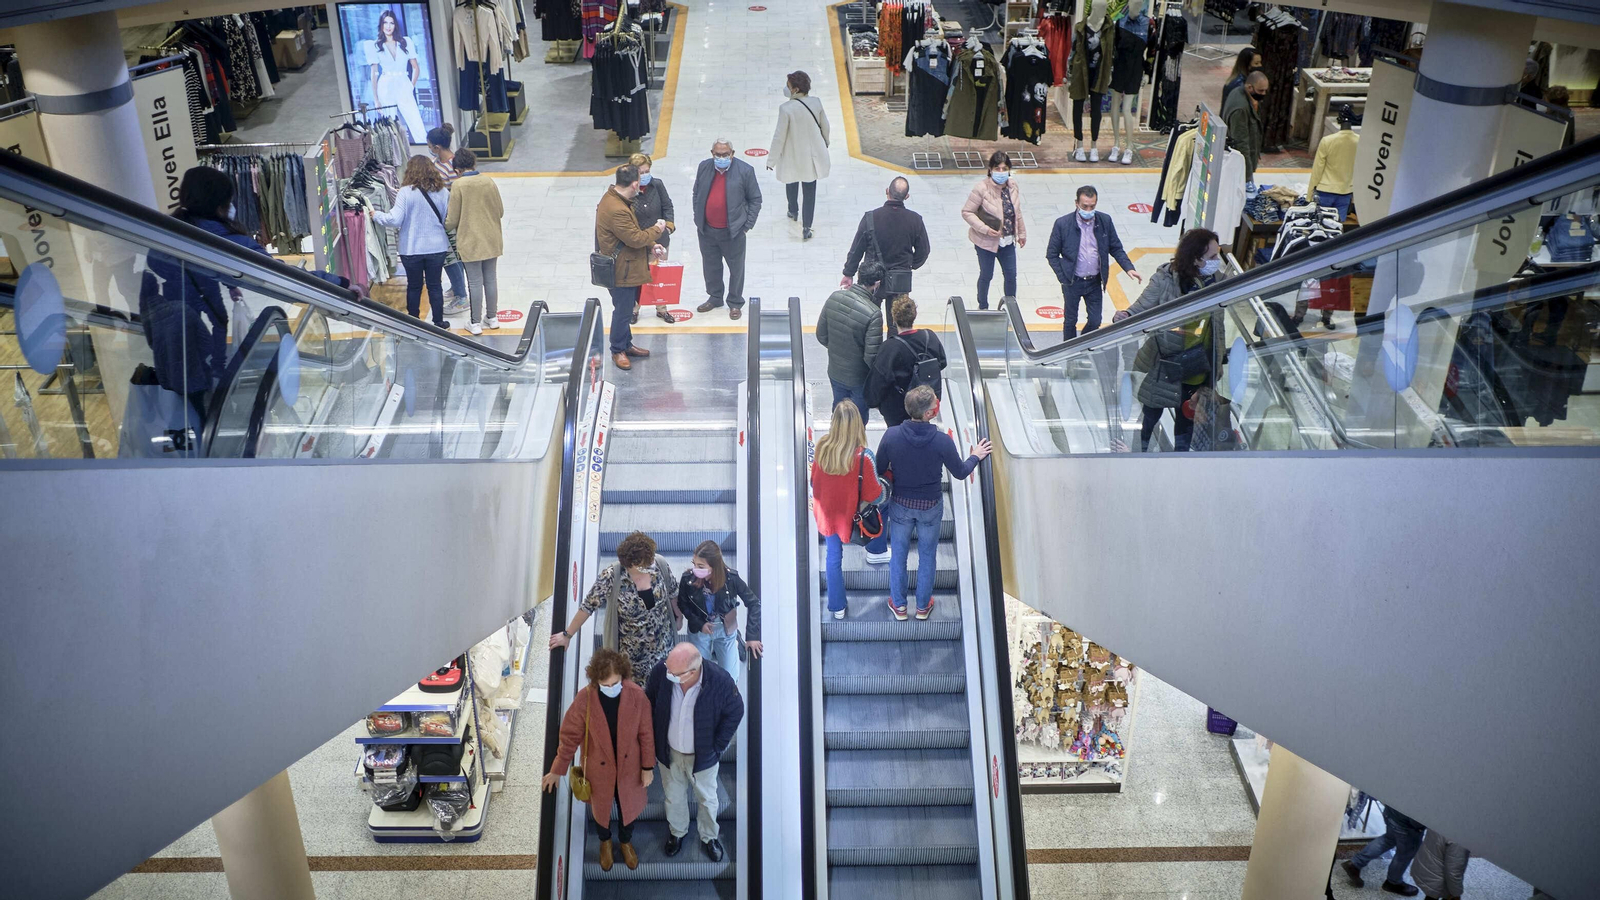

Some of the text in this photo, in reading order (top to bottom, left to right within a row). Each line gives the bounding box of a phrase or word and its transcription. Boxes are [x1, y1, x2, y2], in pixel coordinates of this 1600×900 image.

[151, 96, 171, 141] Ella
[1367, 101, 1399, 200] Joven El
